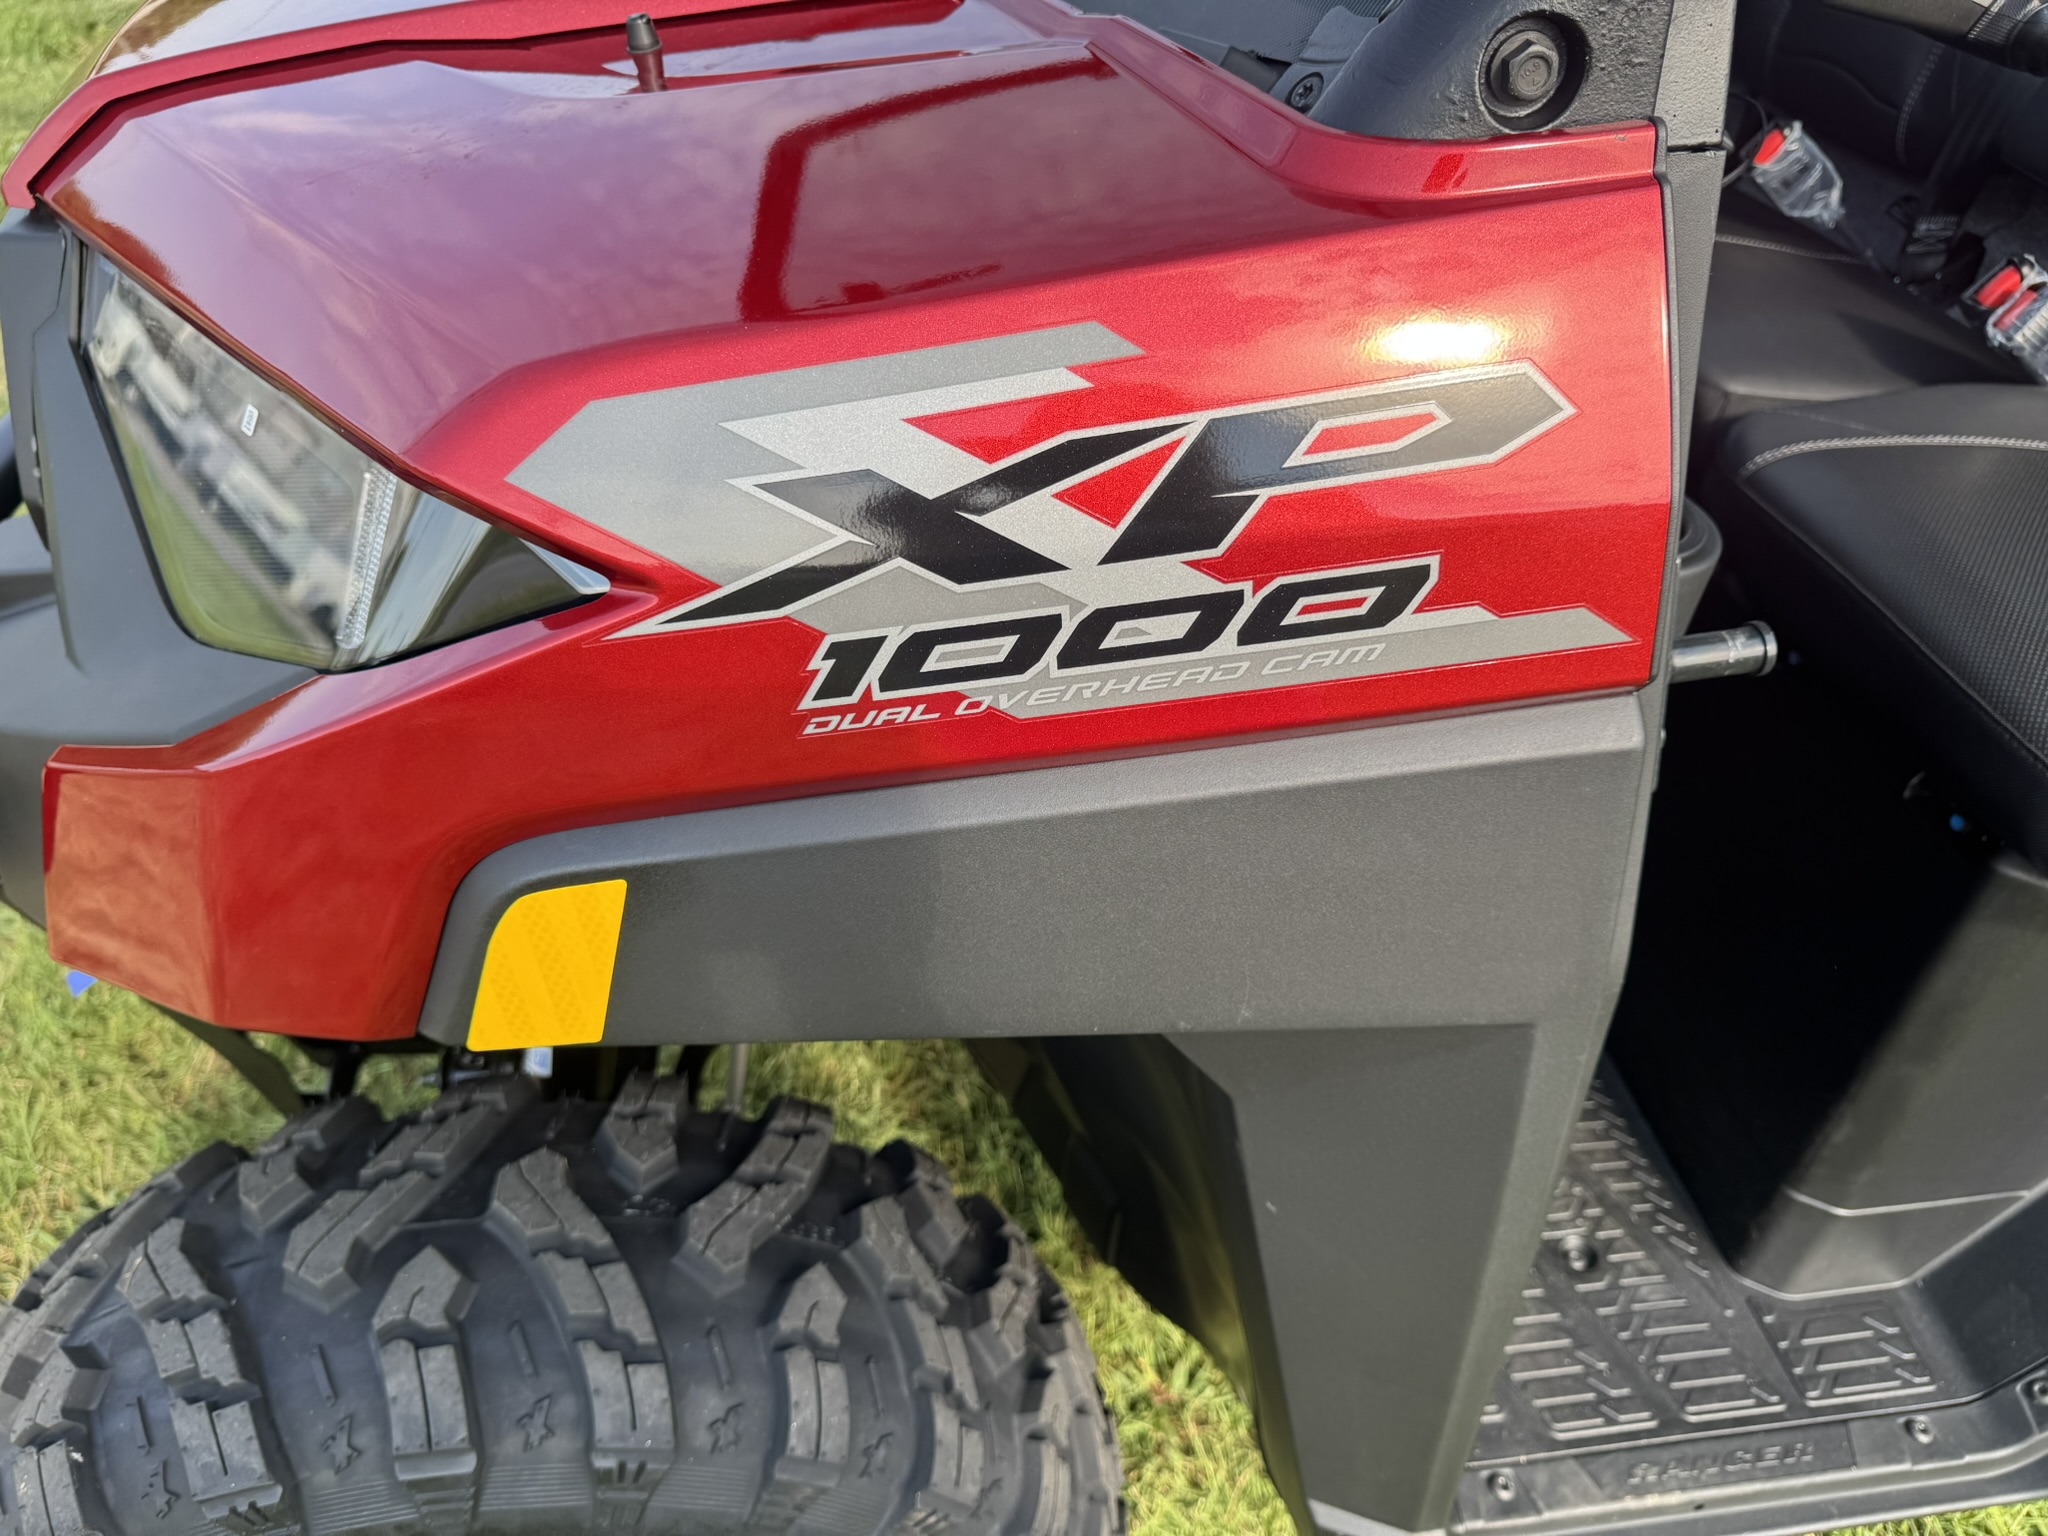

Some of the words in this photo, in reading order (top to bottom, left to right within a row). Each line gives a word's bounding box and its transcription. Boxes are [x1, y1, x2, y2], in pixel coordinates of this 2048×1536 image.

[638, 364, 1573, 630] XP
[802, 703, 941, 736] DUAL
[954, 661, 1251, 717] OVERHEAD
[1261, 642, 1387, 675] CAM
[803, 556, 1438, 708] 1000
[1627, 1442, 1814, 1485] RANGER
